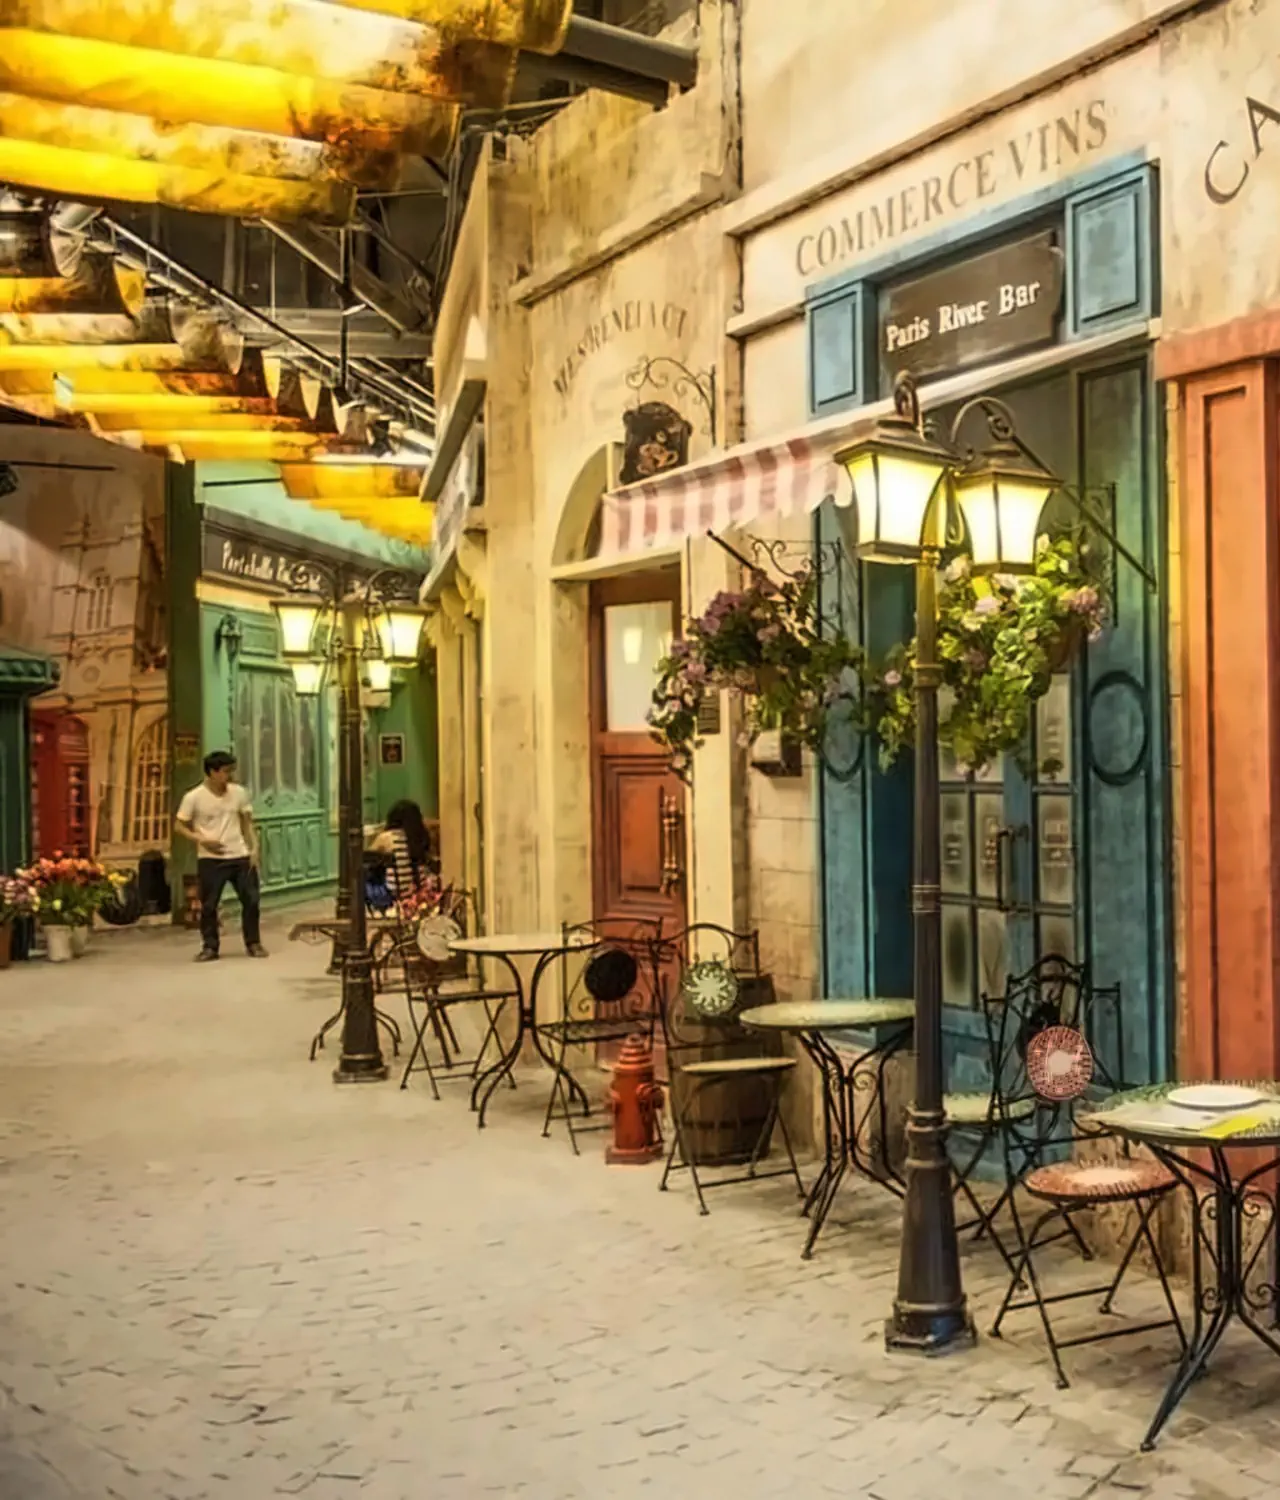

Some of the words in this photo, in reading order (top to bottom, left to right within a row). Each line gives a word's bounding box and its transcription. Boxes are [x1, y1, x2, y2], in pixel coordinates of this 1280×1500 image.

[796, 150, 997, 277] COMMERCE
[1007, 99, 1109, 182] VINS
[886, 316, 931, 353] Paris
[938, 301, 989, 335] River
[998, 281, 1041, 316] Bar
